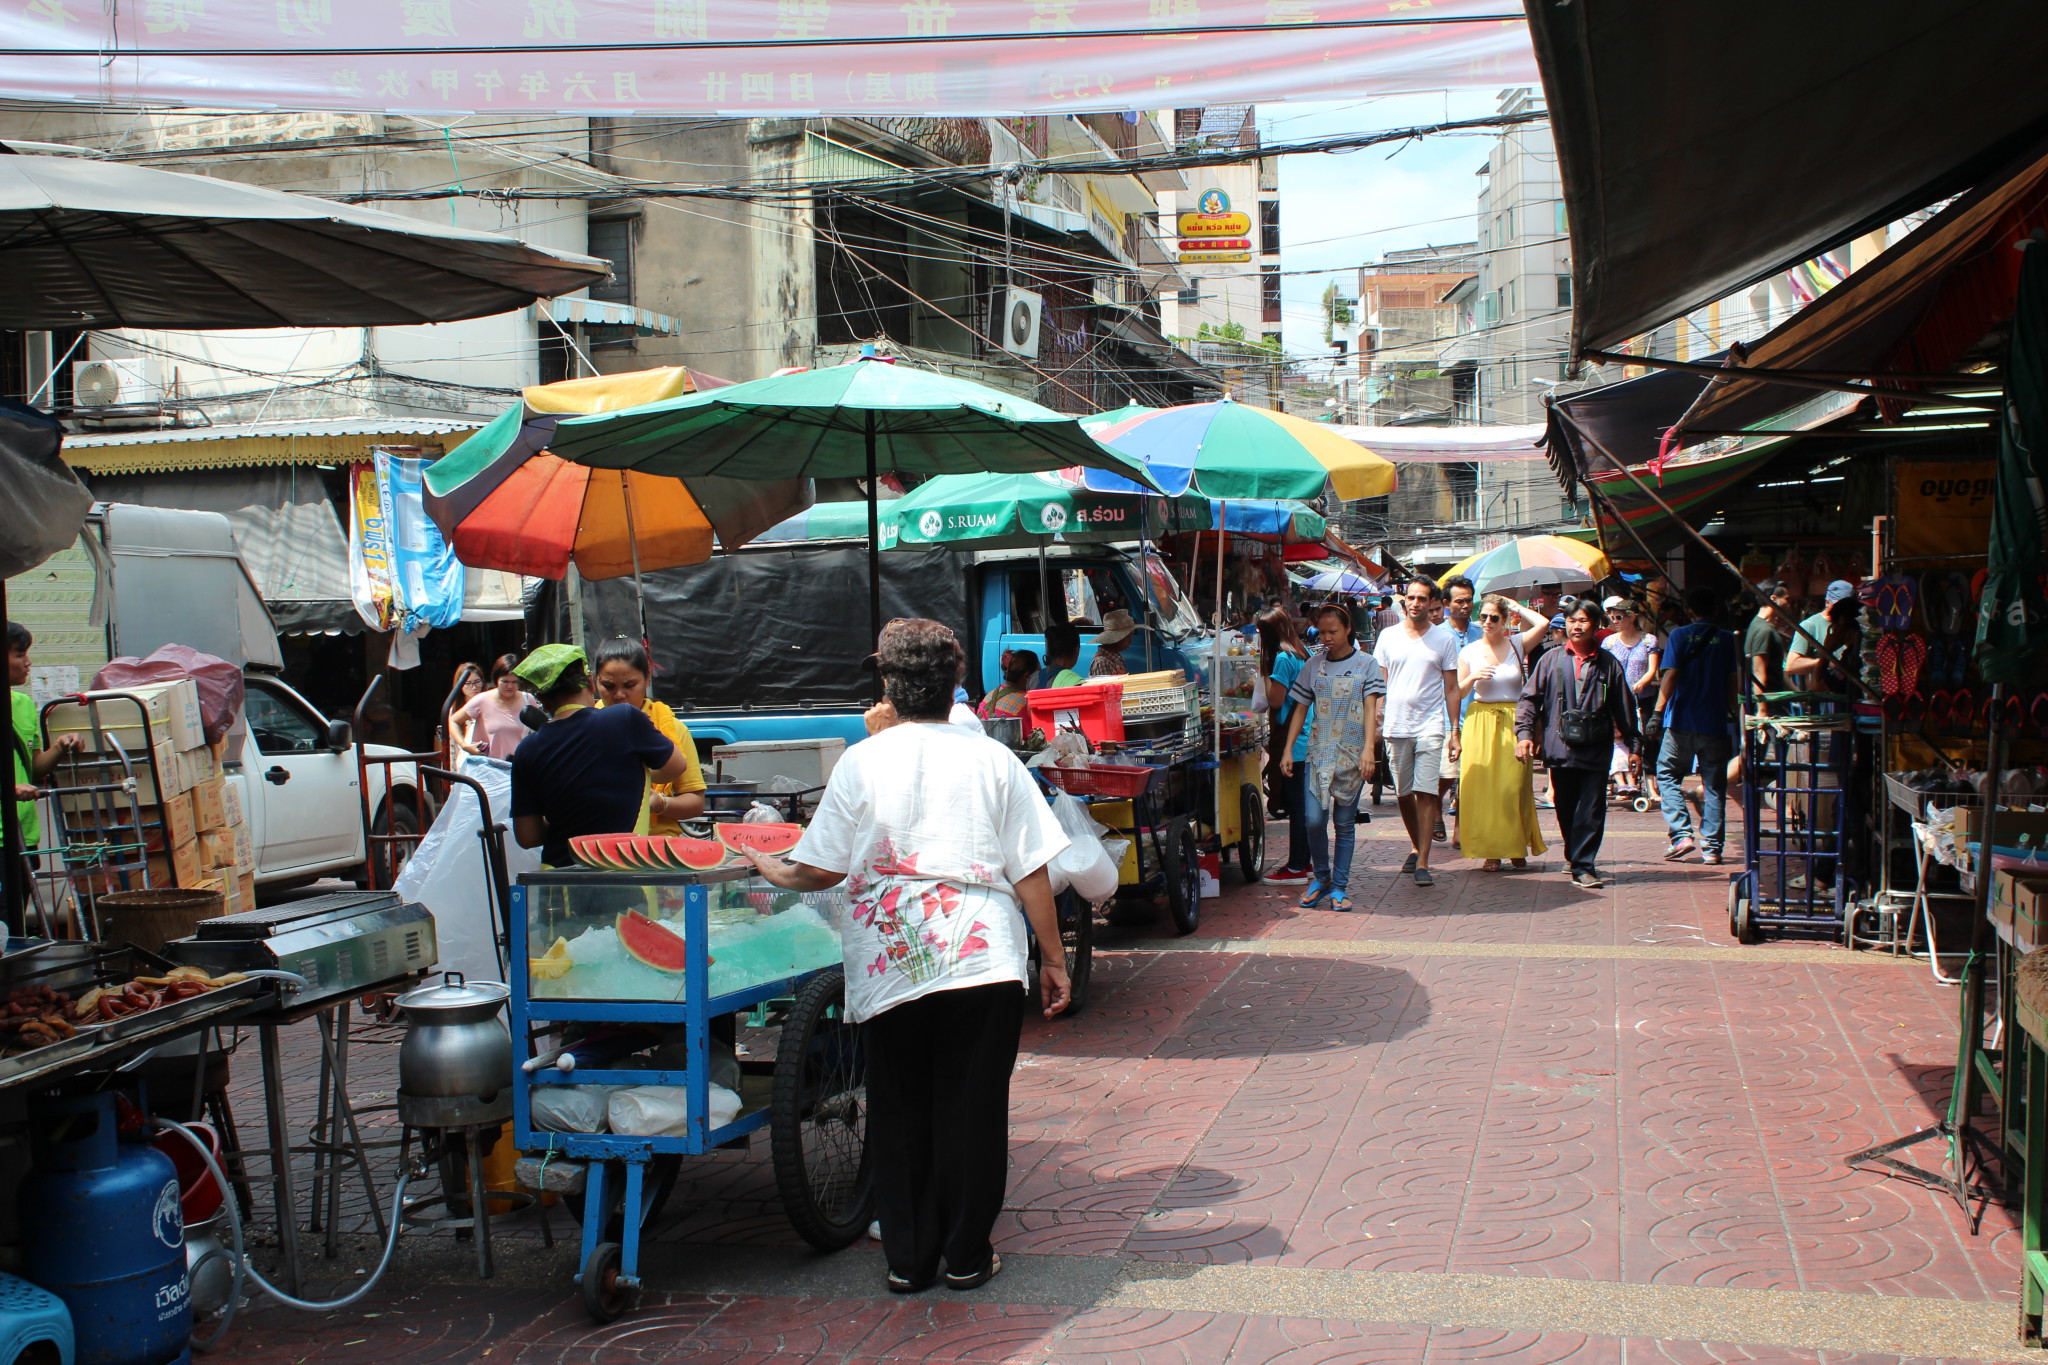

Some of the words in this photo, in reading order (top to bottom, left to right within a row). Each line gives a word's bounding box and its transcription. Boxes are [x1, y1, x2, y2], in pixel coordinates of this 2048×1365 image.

[1076, 506, 1125, 523] ส.ร่วม
[1170, 505, 1197, 519] SUAM
[948, 514, 997, 529] S.RUAM
